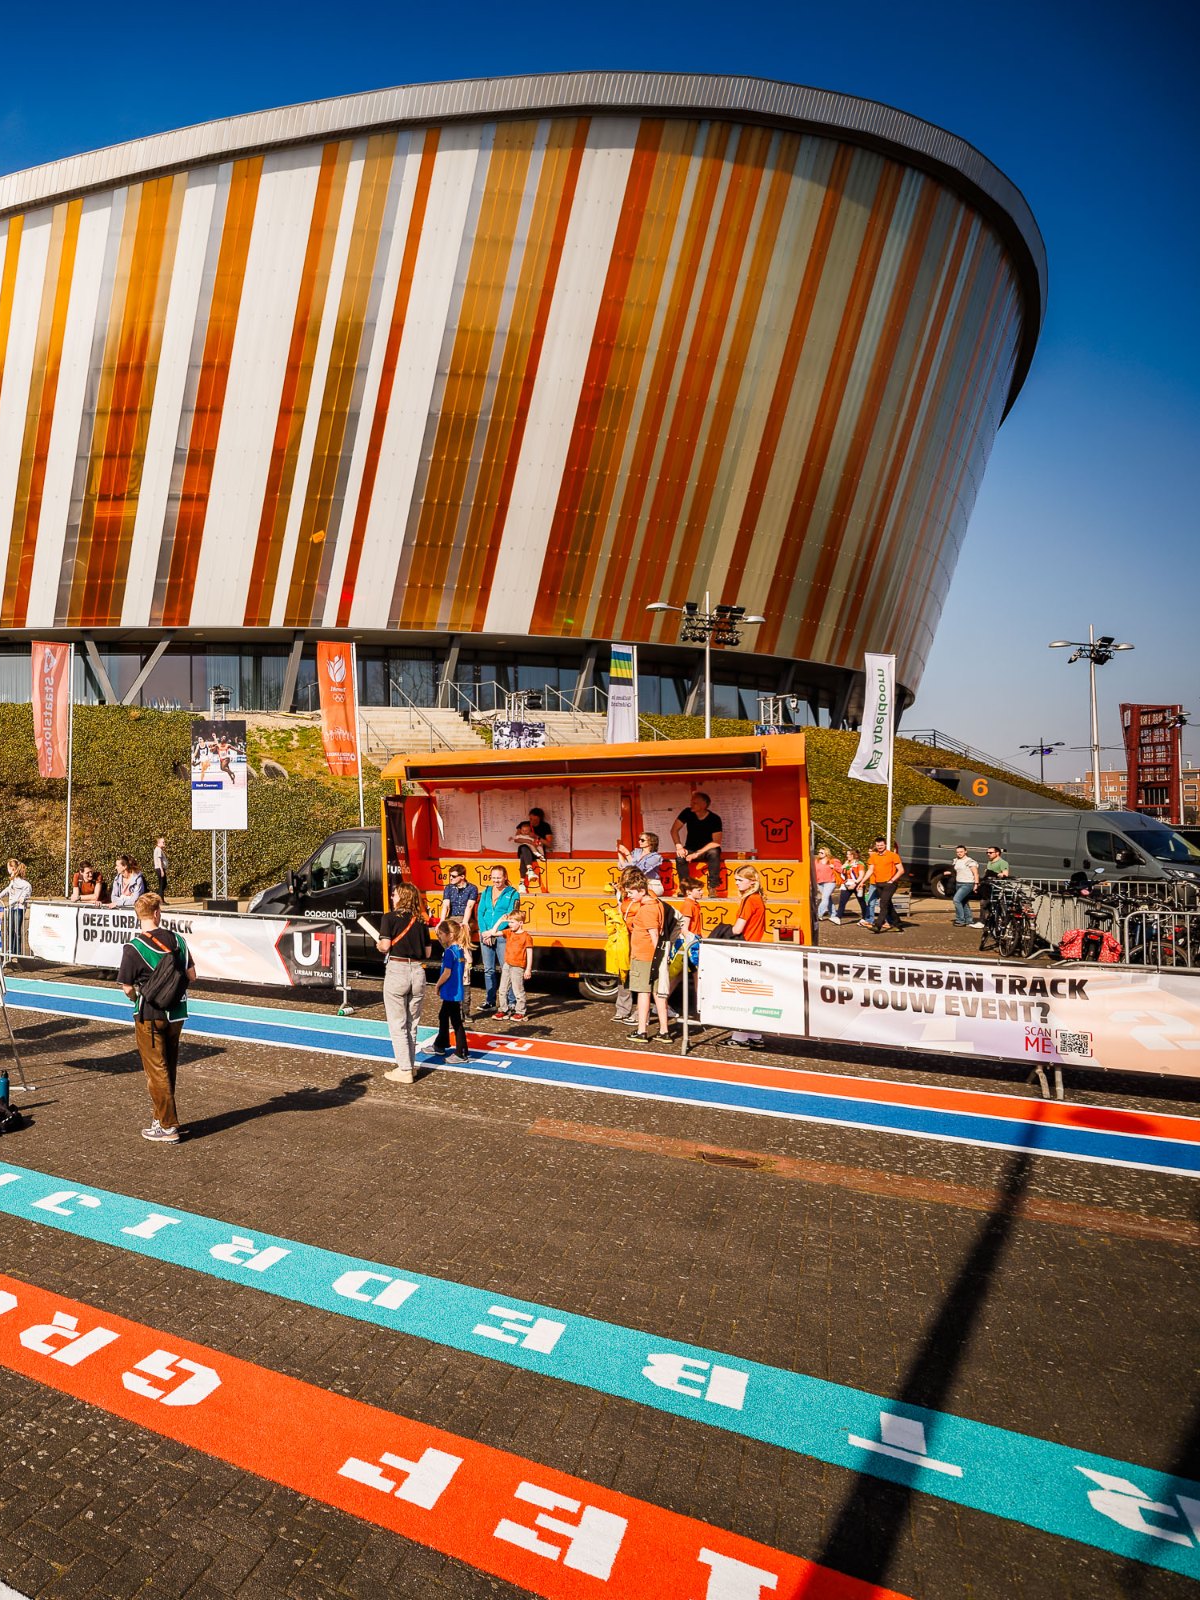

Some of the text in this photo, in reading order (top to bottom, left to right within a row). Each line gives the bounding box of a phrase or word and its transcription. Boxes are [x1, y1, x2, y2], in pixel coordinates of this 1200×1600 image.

[971, 778, 989, 796] 6
[771, 828, 783, 836] 07
[438, 873, 447, 881] 08
[567, 875, 576, 883] 11
[771, 877, 784, 886] 15
[304, 908, 346, 919] papendal
[556, 911, 566, 919] 19
[82, 913, 193, 934] DEZE URBA RACK
[706, 917, 719, 925] 22
[83, 928, 98, 942] OP
[99, 930, 131, 944] JOUW
[293, 931, 336, 967] UT
[294, 969, 333, 979] URBAN TRACKS
[819, 961, 1090, 1001] DEZE URBAN TRACK
[820, 985, 1052, 1024] OP JOUW EVENT?
[1024, 1026, 1052, 1037] SCAN
[1024, 1036, 1052, 1054] ME
